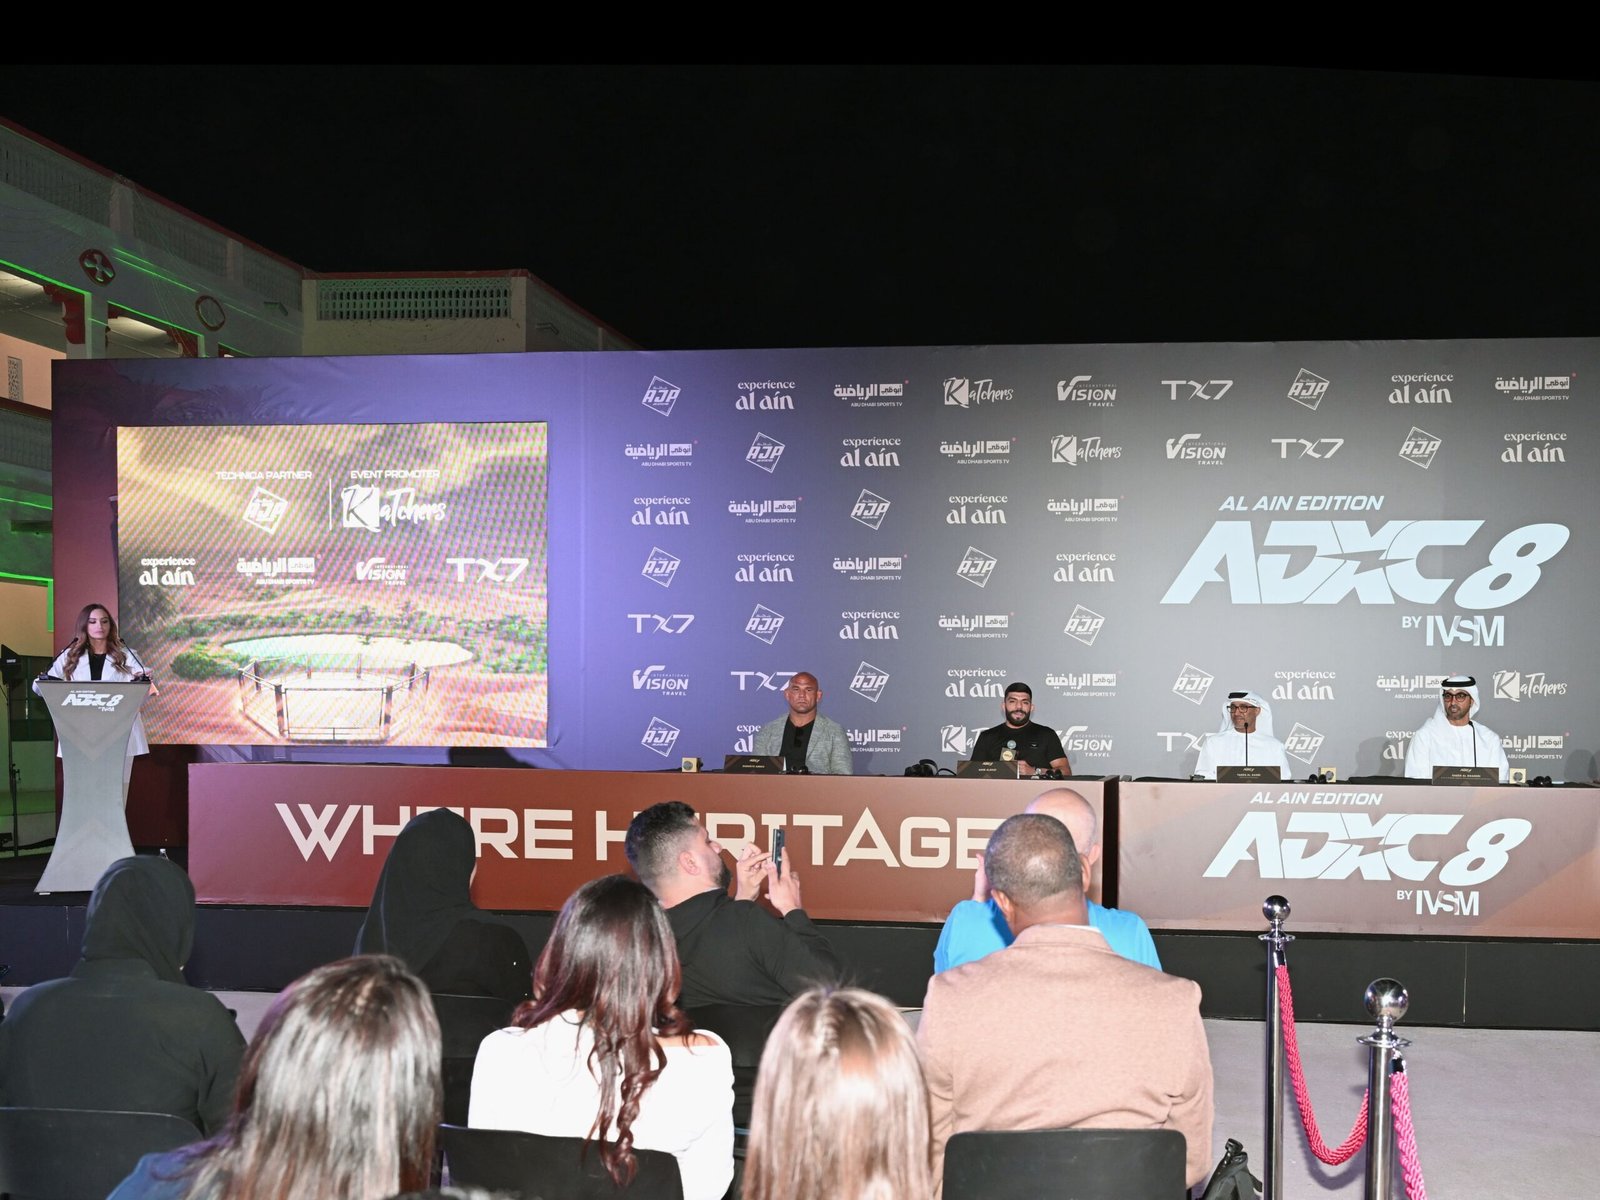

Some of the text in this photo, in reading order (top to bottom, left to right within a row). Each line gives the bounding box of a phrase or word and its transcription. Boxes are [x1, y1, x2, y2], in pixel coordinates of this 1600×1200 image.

[738, 380, 795, 391] experience
[1392, 373, 1453, 384] experience
[1057, 376, 1115, 401] VISION
[1161, 380, 1233, 400] TX7
[1288, 382, 1329, 396] AJP
[1389, 386, 1411, 404] al
[643, 390, 680, 403] AJP
[736, 392, 756, 410] al
[842, 437, 900, 447] experience
[1504, 432, 1567, 443] experience
[746, 446, 784, 459] AJP
[1166, 434, 1225, 459] VISION
[1271, 438, 1344, 459] TX7
[1400, 441, 1441, 455] AJP
[1501, 444, 1524, 462] al
[840, 449, 861, 466] al
[266, 471, 312, 479] PARTNER
[351, 470, 440, 479] EVENT PROMOTER
[634, 496, 690, 506] experience
[948, 494, 1008, 505] experience
[1219, 495, 1384, 511] AL AIN EDITION
[632, 508, 652, 525] al
[852, 503, 890, 516] AJP
[946, 506, 967, 524] al
[737, 553, 794, 563] experience
[1056, 552, 1116, 563] experience
[1160, 520, 1570, 609] ADXC 8
[643, 561, 679, 574] AJP
[735, 565, 755, 582] al
[958, 560, 996, 574] AJP
[1054, 564, 1075, 582] al
[139, 567, 158, 585] al
[842, 610, 900, 620] experience
[1402, 616, 1422, 628] BY
[627, 614, 695, 634] TX7
[746, 618, 783, 631] AJP
[840, 622, 861, 639] al
[1065, 618, 1104, 632] AJP
[633, 665, 687, 689] VISION
[947, 668, 1007, 679] experience
[1275, 670, 1335, 681] experience
[851, 675, 888, 688] AJP
[1173, 677, 1213, 691] AJP
[945, 680, 966, 698] al
[1272, 682, 1294, 700] al
[642, 731, 679, 744] AJP
[734, 734, 753, 753] al
[847, 729, 875, 745] الرياض
[1157, 732, 1216, 751] TX
[1285, 737, 1320, 749] AJP
[1502, 736, 1536, 751] الرياض
[1383, 741, 1404, 760] al
[1250, 792, 1383, 805] AL AIN EDITION
[274, 803, 1005, 869] WHRE HRITAGE
[1202, 811, 1532, 886] ADXC 8
[1397, 891, 1413, 900] BY
